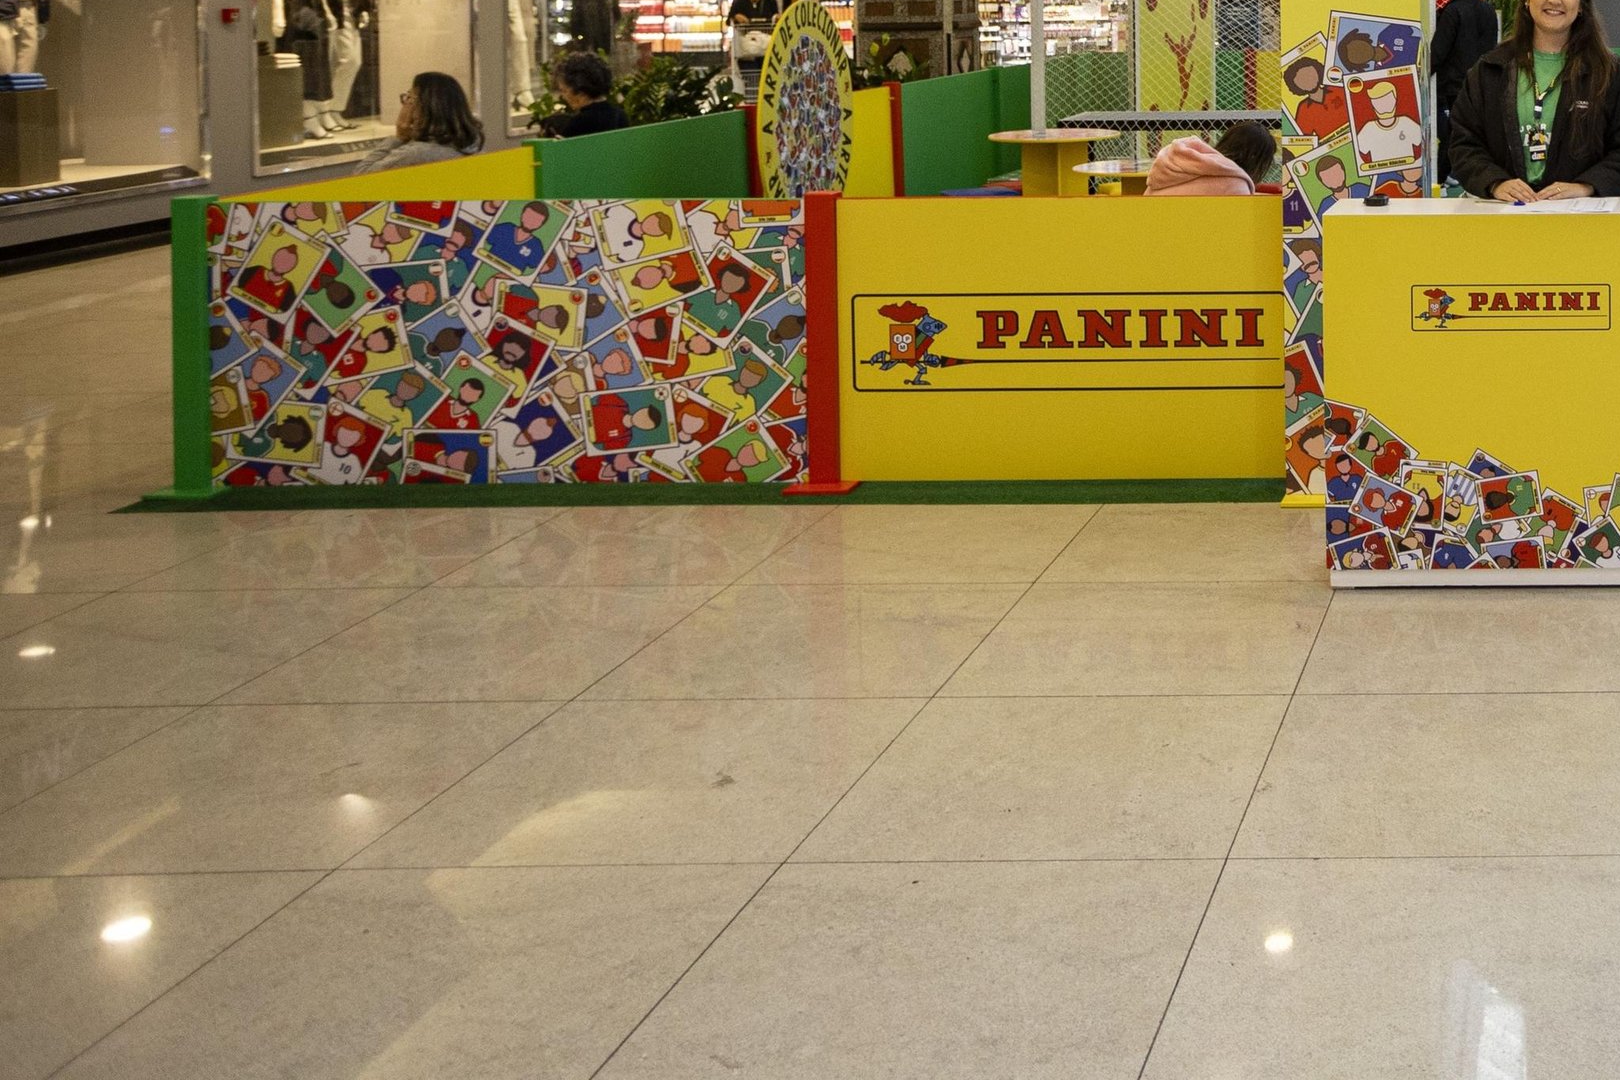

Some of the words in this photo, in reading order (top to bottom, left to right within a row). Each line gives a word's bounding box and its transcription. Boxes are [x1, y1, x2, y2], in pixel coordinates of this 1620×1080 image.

[780, 16, 794, 49] DE
[794, 0, 848, 76] COLECIONAR
[1393, 38, 1404, 51] 10
[764, 44, 782, 108] ARTE
[842, 108, 852, 120] A
[763, 121, 774, 134] A
[1399, 130, 1406, 141] 6
[1290, 201, 1298, 211] 11
[1468, 292, 1600, 312] PANINI
[976, 308, 1264, 348] PANINI
